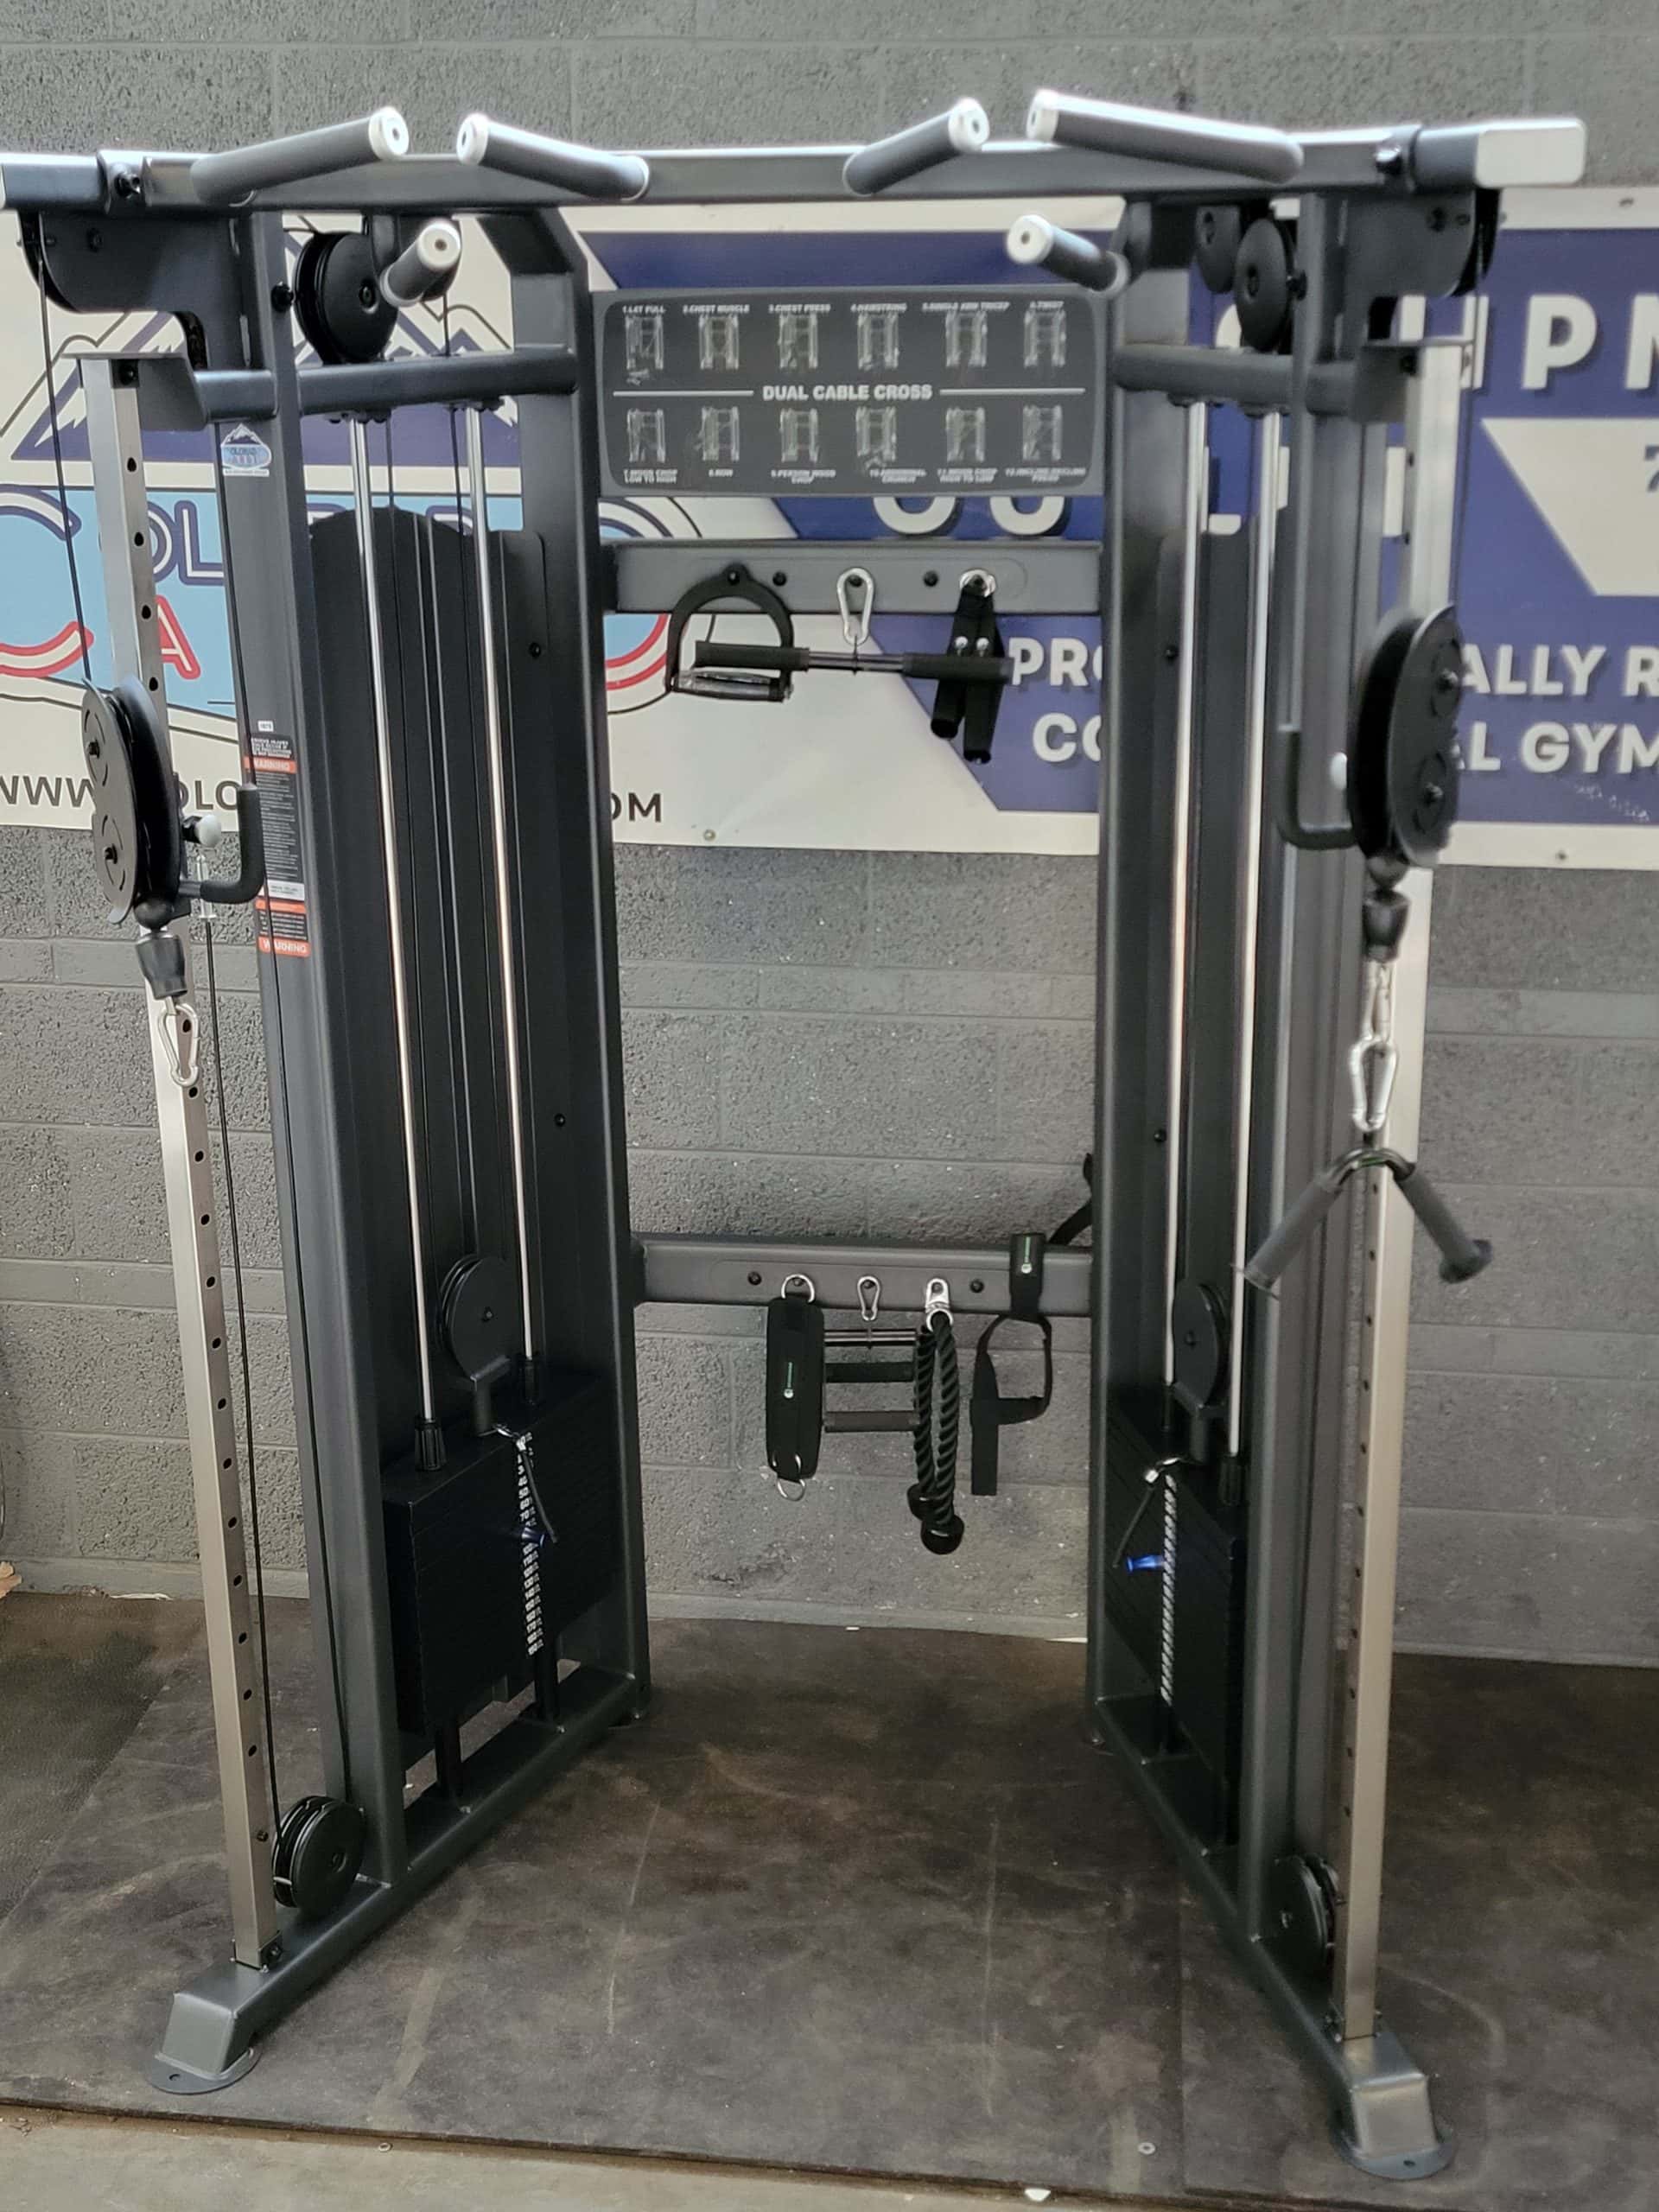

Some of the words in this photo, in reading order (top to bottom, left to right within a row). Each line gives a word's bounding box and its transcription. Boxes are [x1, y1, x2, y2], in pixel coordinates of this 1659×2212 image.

[762, 385, 809, 401] DUAL
[812, 385, 869, 401] CABLE
[874, 384, 933, 400] CROSS
